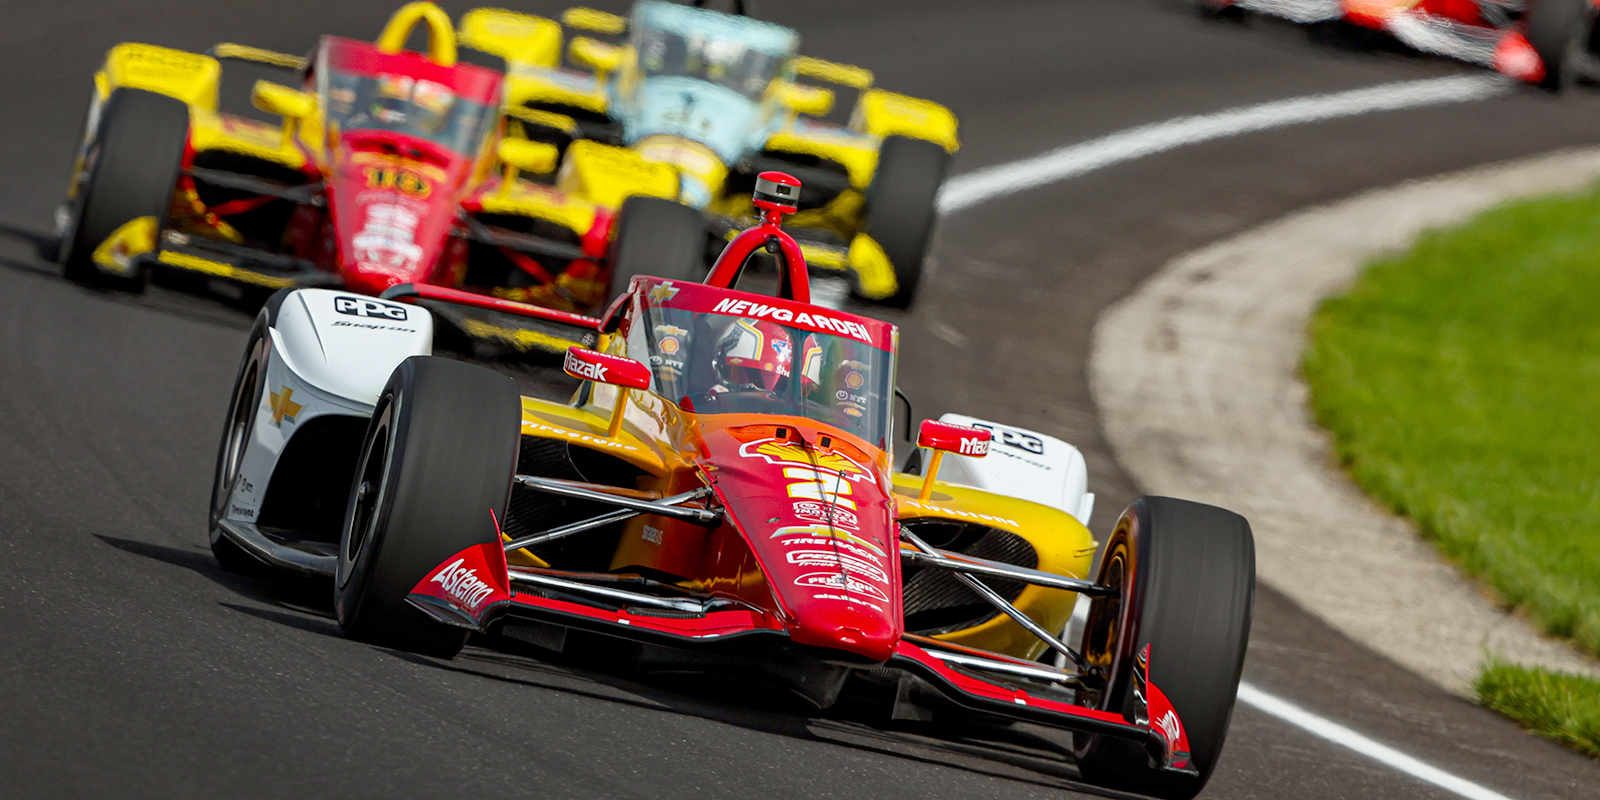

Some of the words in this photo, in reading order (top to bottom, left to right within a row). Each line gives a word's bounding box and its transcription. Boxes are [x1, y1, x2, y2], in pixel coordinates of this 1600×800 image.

[363, 167, 431, 198] 10
[336, 297, 407, 321] PPG
[712, 298, 873, 343] NEWGARDEN
[565, 350, 608, 382] Mazak
[665, 359, 684, 369] NTT
[522, 420, 638, 450] Firestone
[782, 467, 857, 511] 2
[906, 500, 1020, 527] Firestone
[781, 538, 827, 546] TIRE
[828, 539, 884, 568] RACK
[796, 553, 882, 575] PENSKE
[430, 558, 494, 608] Astemo
[808, 574, 877, 595] PENNZOIL
[813, 593, 883, 612] dallara
